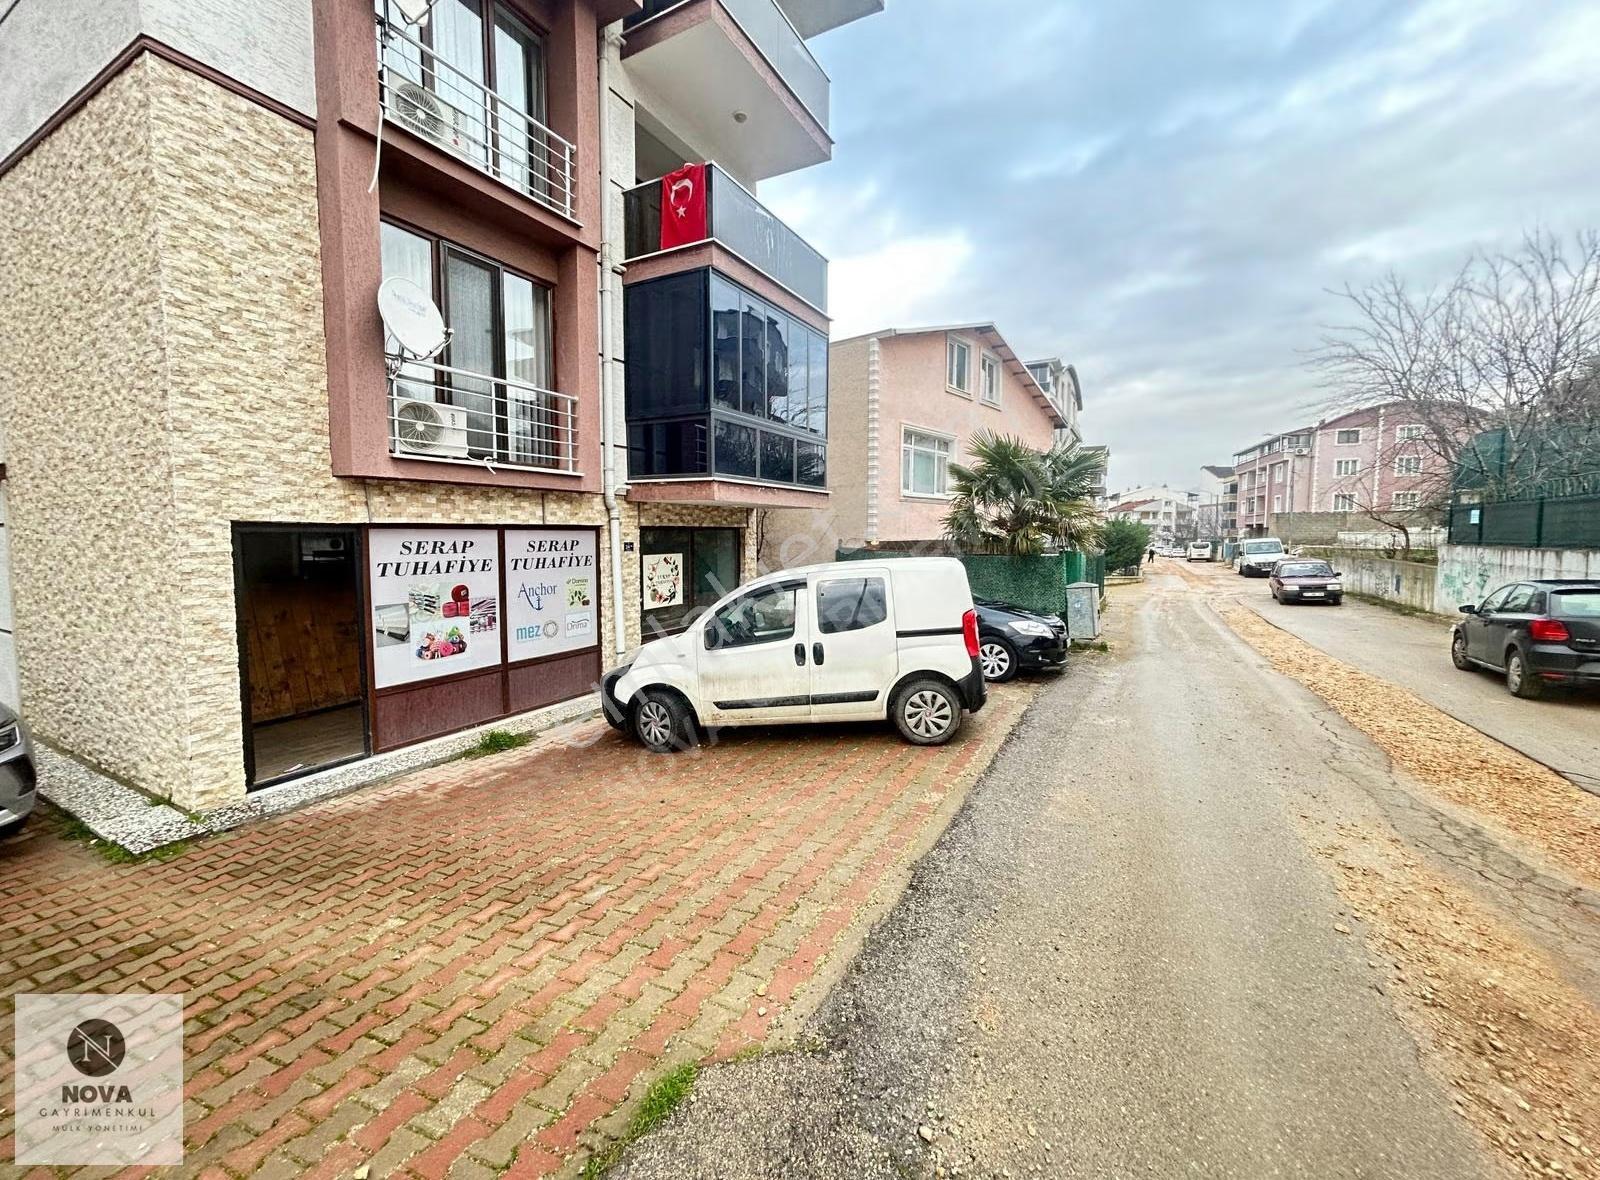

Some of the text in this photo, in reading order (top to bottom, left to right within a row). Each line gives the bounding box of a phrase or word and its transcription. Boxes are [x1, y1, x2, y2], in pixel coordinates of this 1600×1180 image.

[399, 540, 475, 556] SERAP
[526, 539, 580, 553] SERAP
[376, 556, 493, 577] TUHAFİYE
[511, 553, 593, 571] TUHAFİYE
[517, 581, 558, 599] Anchor
[516, 624, 541, 641] mez
